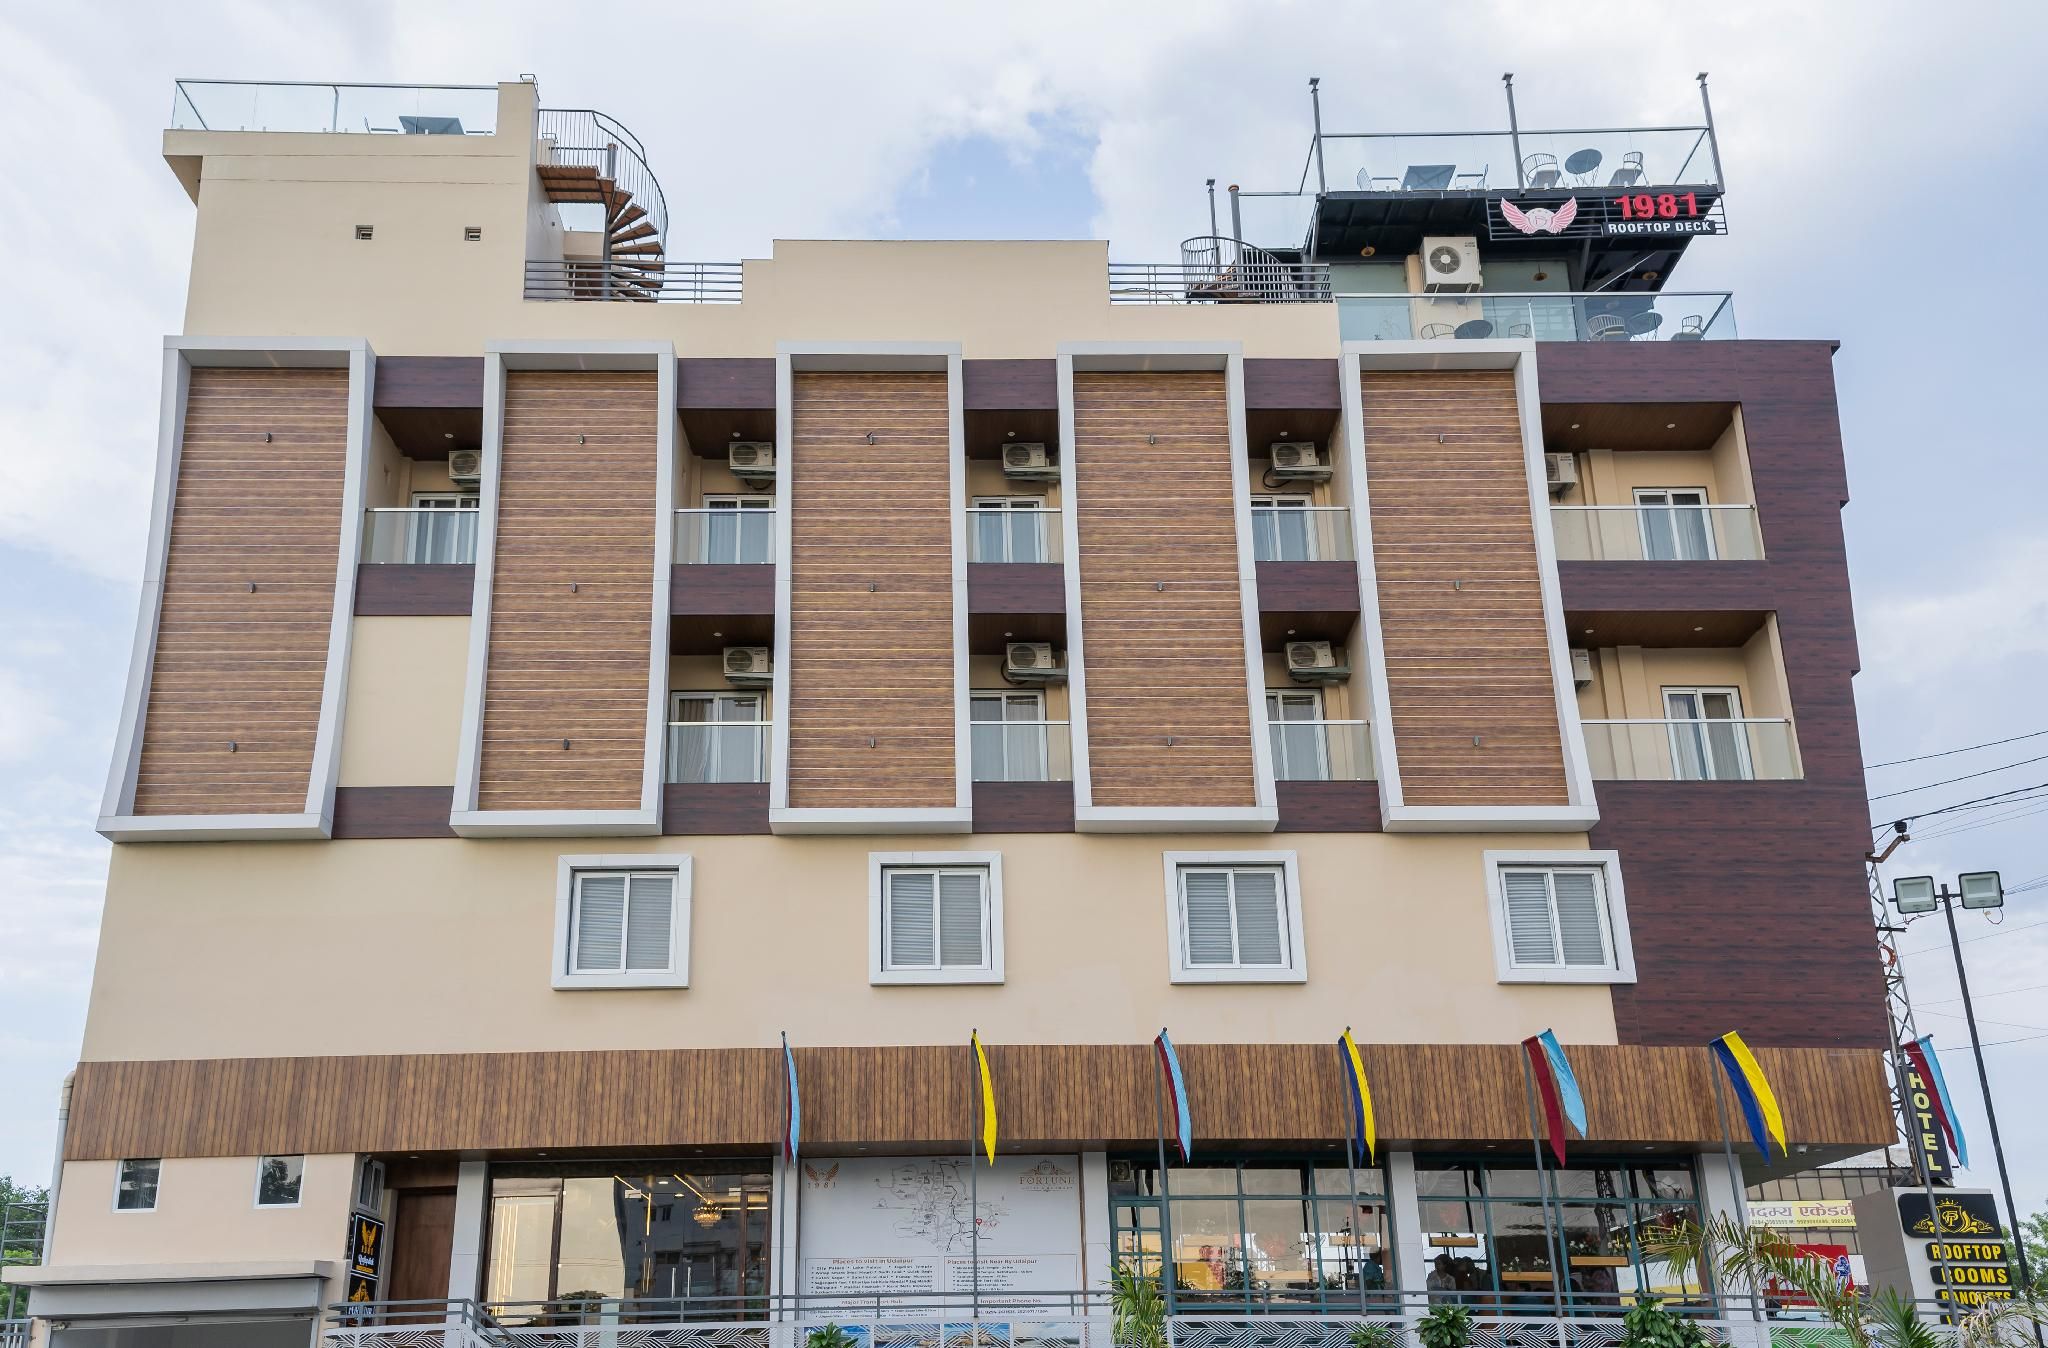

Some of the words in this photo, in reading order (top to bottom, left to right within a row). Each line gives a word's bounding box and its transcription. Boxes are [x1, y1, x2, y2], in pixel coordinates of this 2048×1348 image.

[1614, 192, 1697, 219] 1981
[1608, 222, 1671, 234] ROOFTOP
[1675, 221, 1711, 232] DECK
[1908, 1072, 1943, 1172] HOTEL
[1931, 1244, 2001, 1260] ROOFTOP
